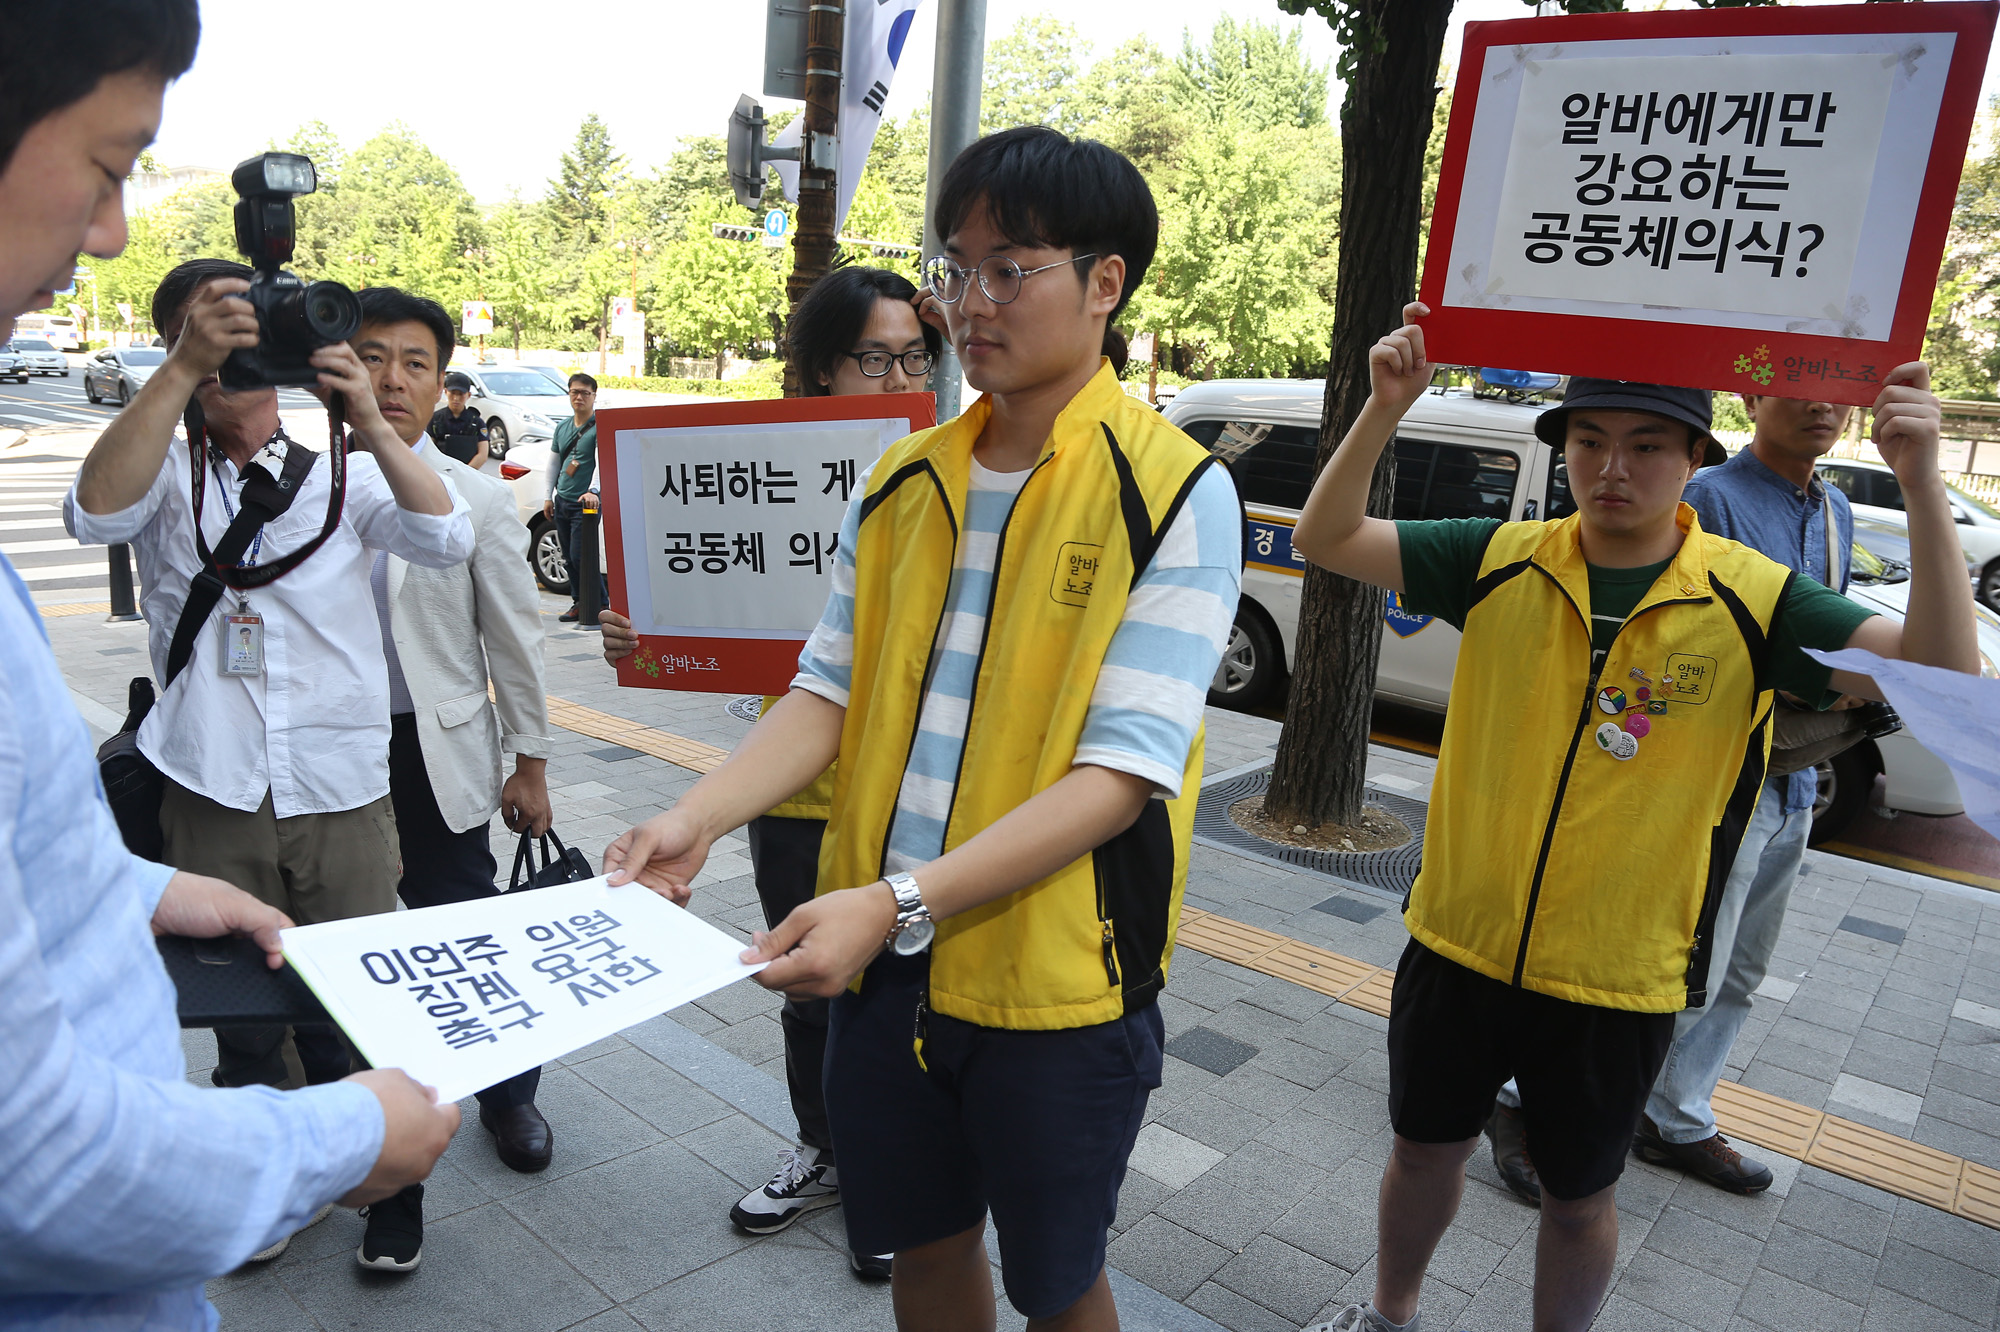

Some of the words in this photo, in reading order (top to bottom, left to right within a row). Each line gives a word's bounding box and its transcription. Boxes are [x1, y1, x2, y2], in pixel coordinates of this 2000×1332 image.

[1561, 91, 1837, 148] 알바에게만
[1574, 152, 1790, 211] 강요하는
[1523, 212, 1825, 278] 공동체의식?
[1783, 356, 1879, 383] 알바노조
[333, 434, 343, 489] Canon
[659, 460, 798, 505] 사퇴하는
[821, 458, 855, 501] 게
[663, 531, 766, 574] 공동체
[1069, 554, 1099, 576] 알바
[1063, 578, 1093, 596] 노조
[1387, 607, 1423, 623] POLICE
[661, 653, 721, 675] 알바노조
[1677, 663, 1706, 680] 알바
[1674, 682, 1700, 695] 노조
[360, 934, 508, 985] 이언주
[525, 909, 623, 952] 의원
[408, 970, 520, 1018] 징계
[531, 936, 627, 984] 요구
[437, 1000, 544, 1050] 촉구
[567, 955, 662, 1007] 서한
